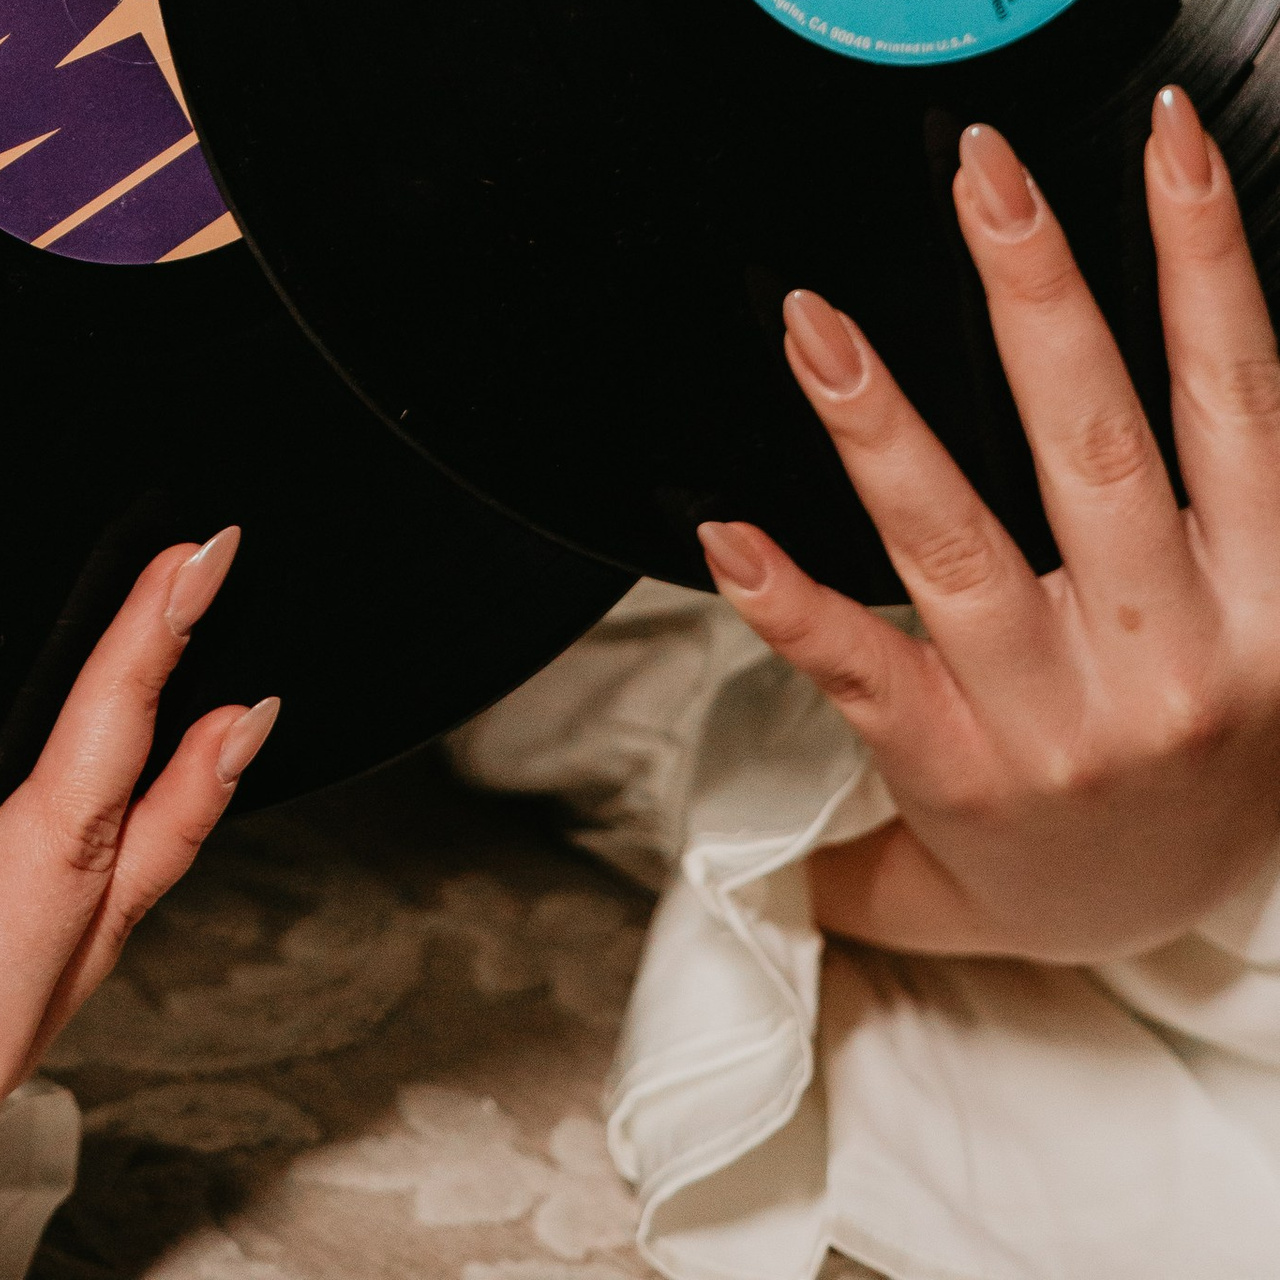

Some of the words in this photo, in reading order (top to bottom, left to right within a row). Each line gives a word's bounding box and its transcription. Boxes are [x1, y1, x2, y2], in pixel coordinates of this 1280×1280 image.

[809, 16, 828, 34] CA
[875, 40, 919, 53] Printed
[936, 33, 977, 52] U.S.A.
